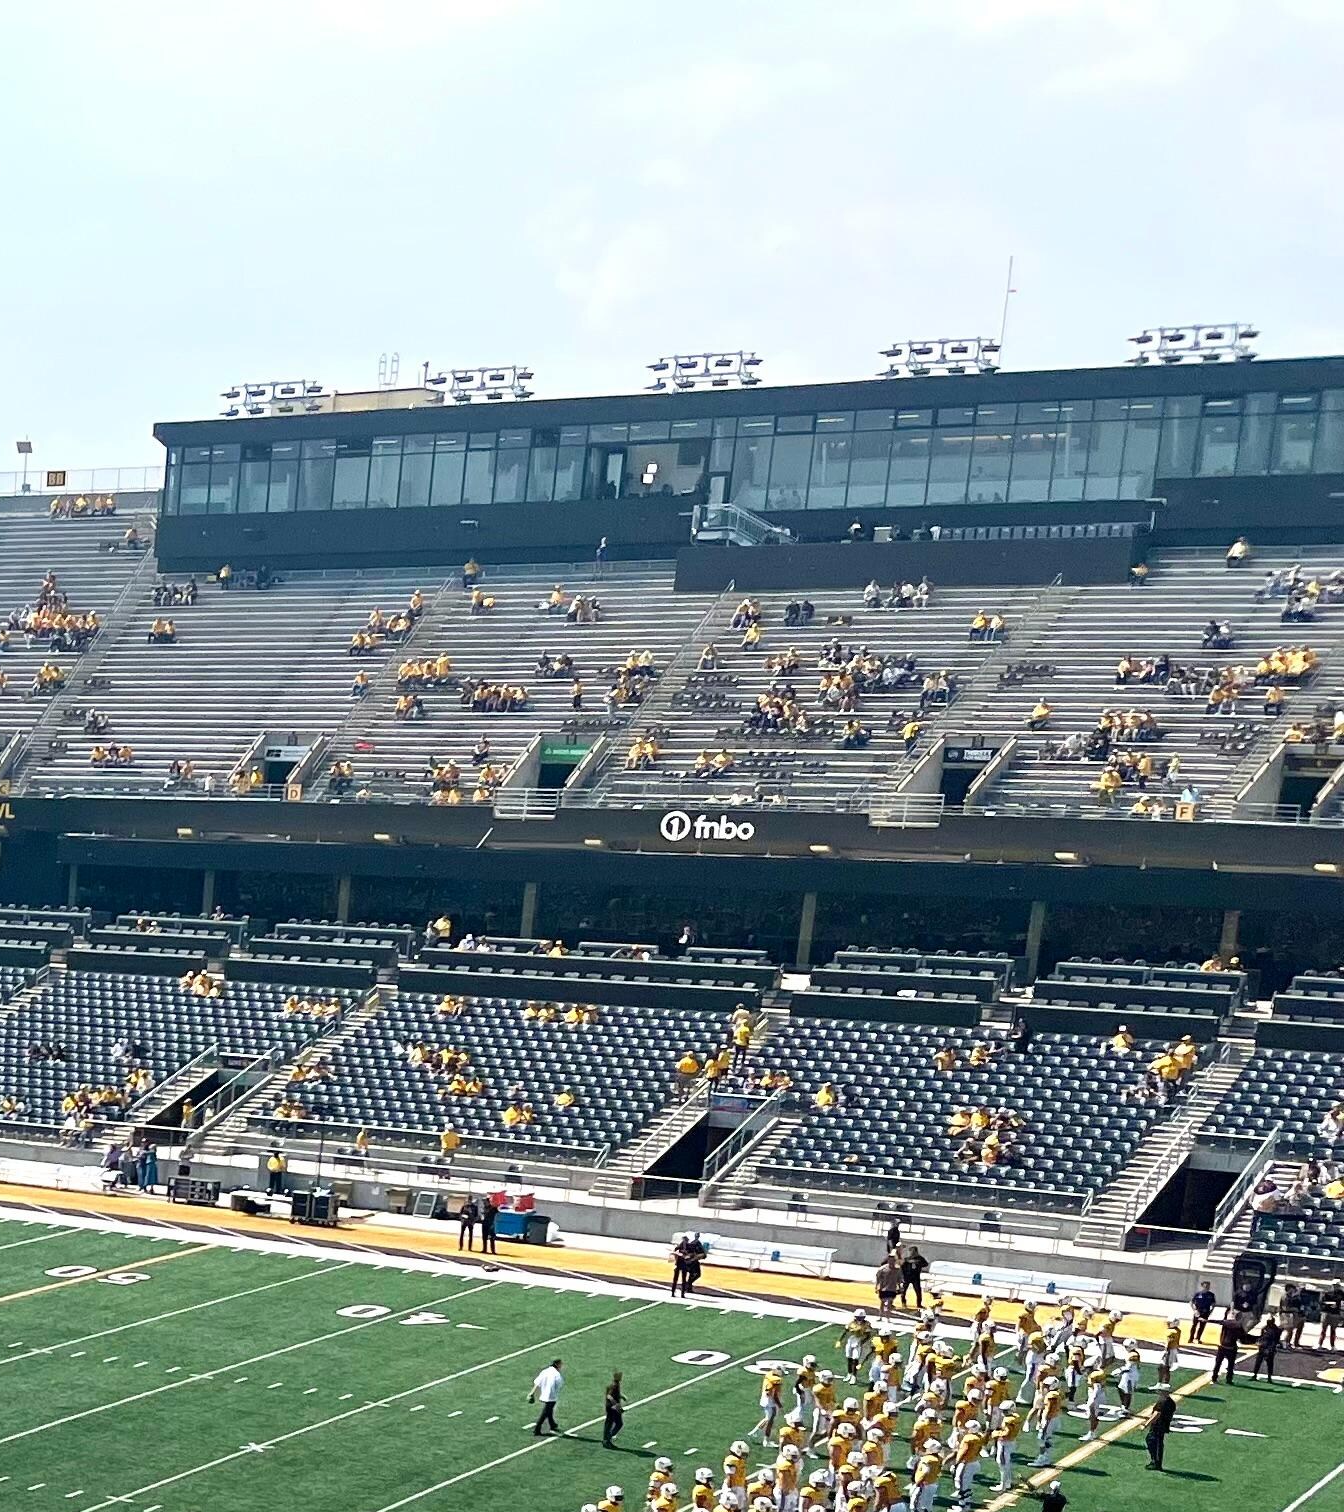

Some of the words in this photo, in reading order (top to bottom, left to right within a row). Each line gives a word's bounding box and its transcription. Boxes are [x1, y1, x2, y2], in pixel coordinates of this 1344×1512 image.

[693, 814, 755, 840] fnbo
[44, 1264, 151, 1286] 50
[335, 1303, 451, 1325] 40
